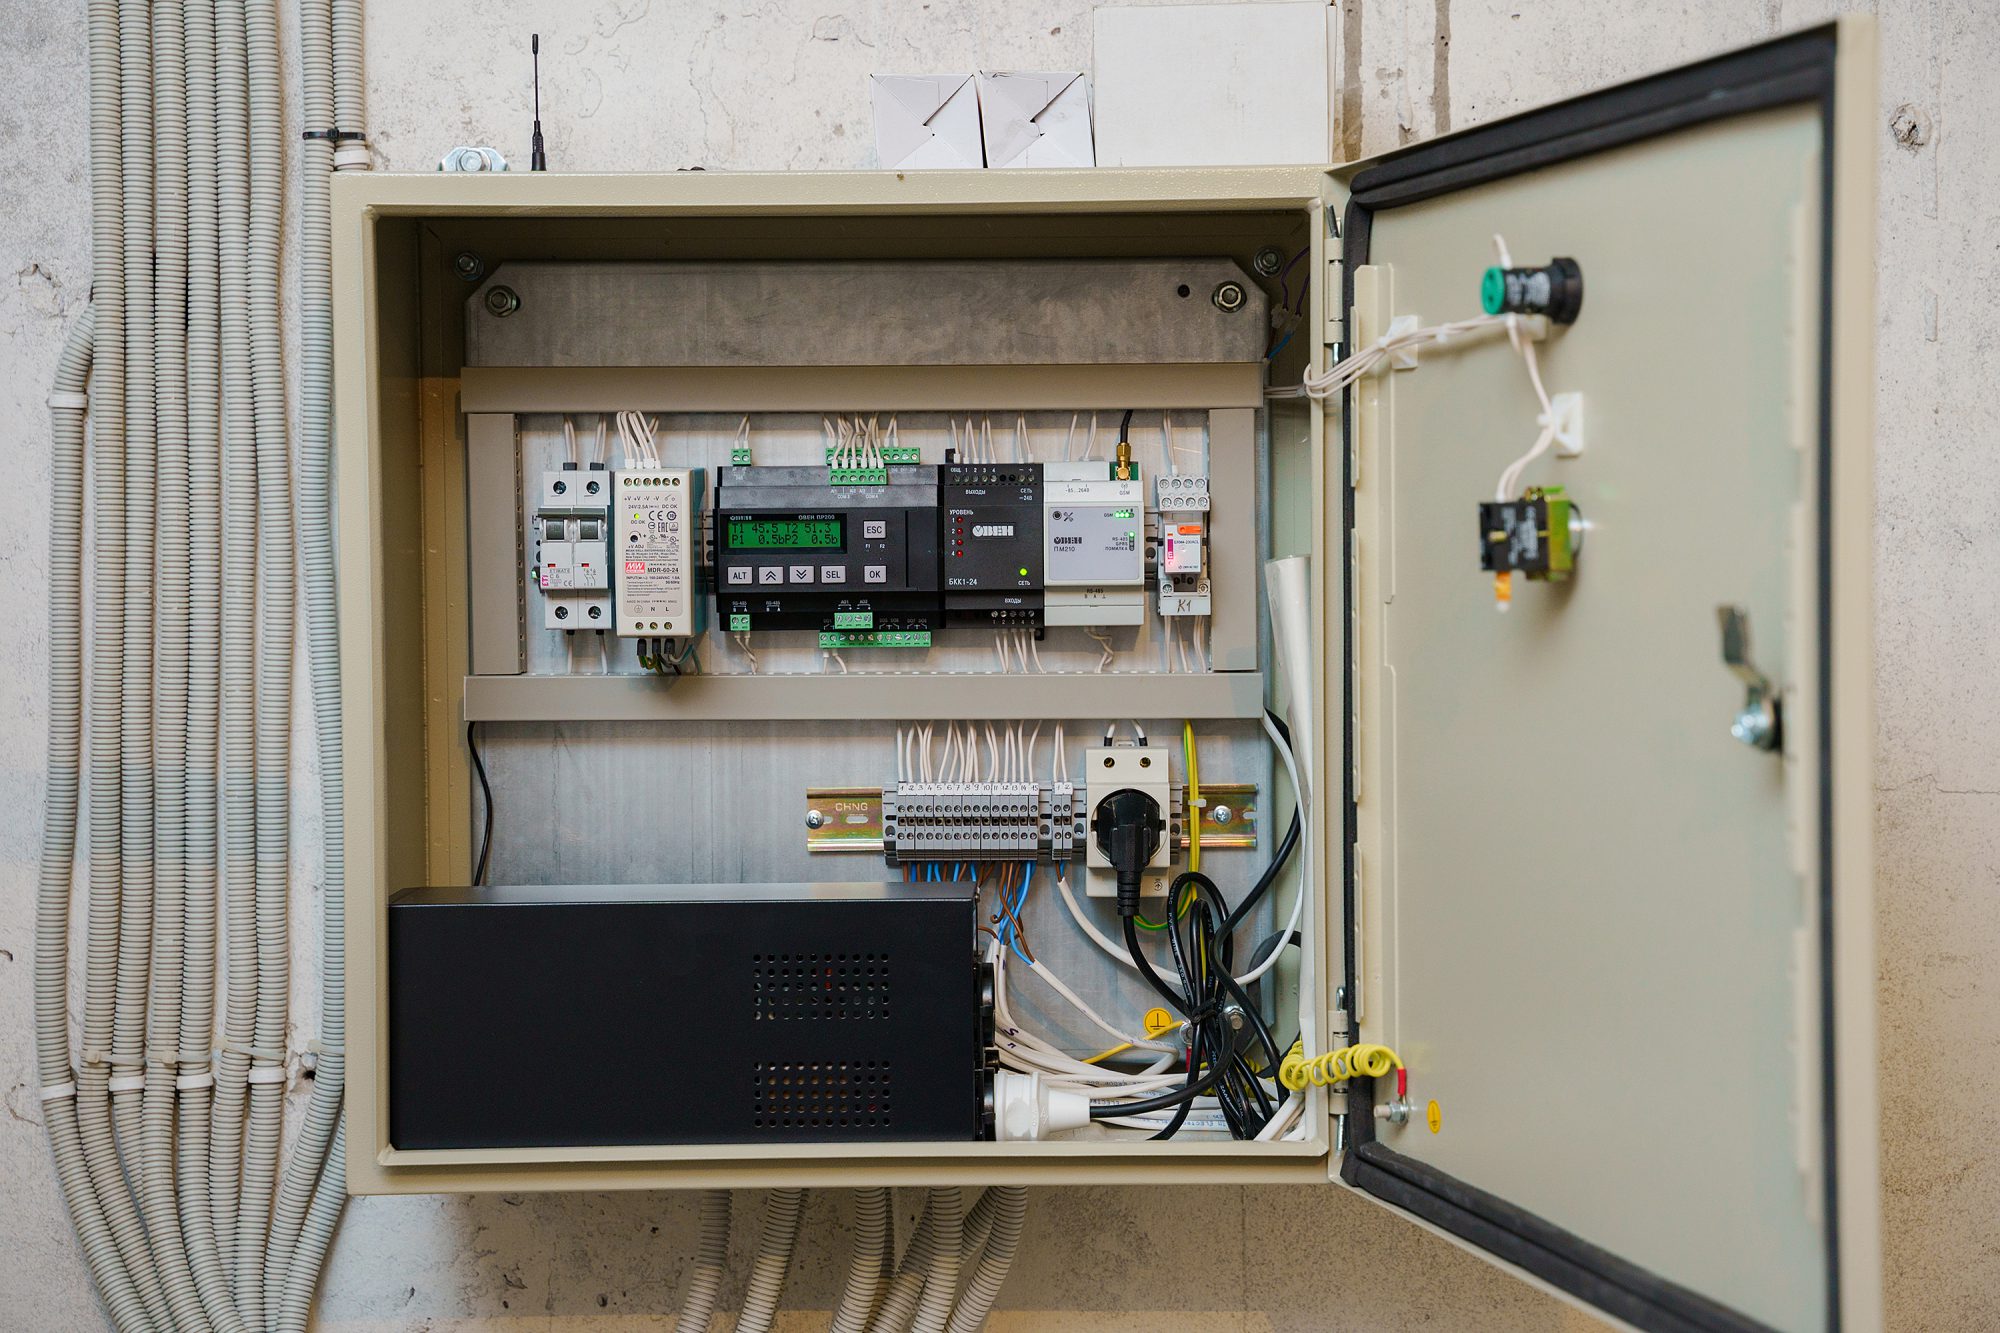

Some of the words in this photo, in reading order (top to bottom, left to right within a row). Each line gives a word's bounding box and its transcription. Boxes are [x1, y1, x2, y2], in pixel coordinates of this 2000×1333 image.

[732, 523, 744, 533] T1
[752, 523, 778, 533] 45.5
[785, 523, 798, 533] T2
[804, 523, 832, 533] 51.3
[732, 535, 744, 544] P1
[811, 535, 837, 544] 0.5b
[1177, 599, 1192, 613] K1
[836, 803, 868, 811] CHNG
